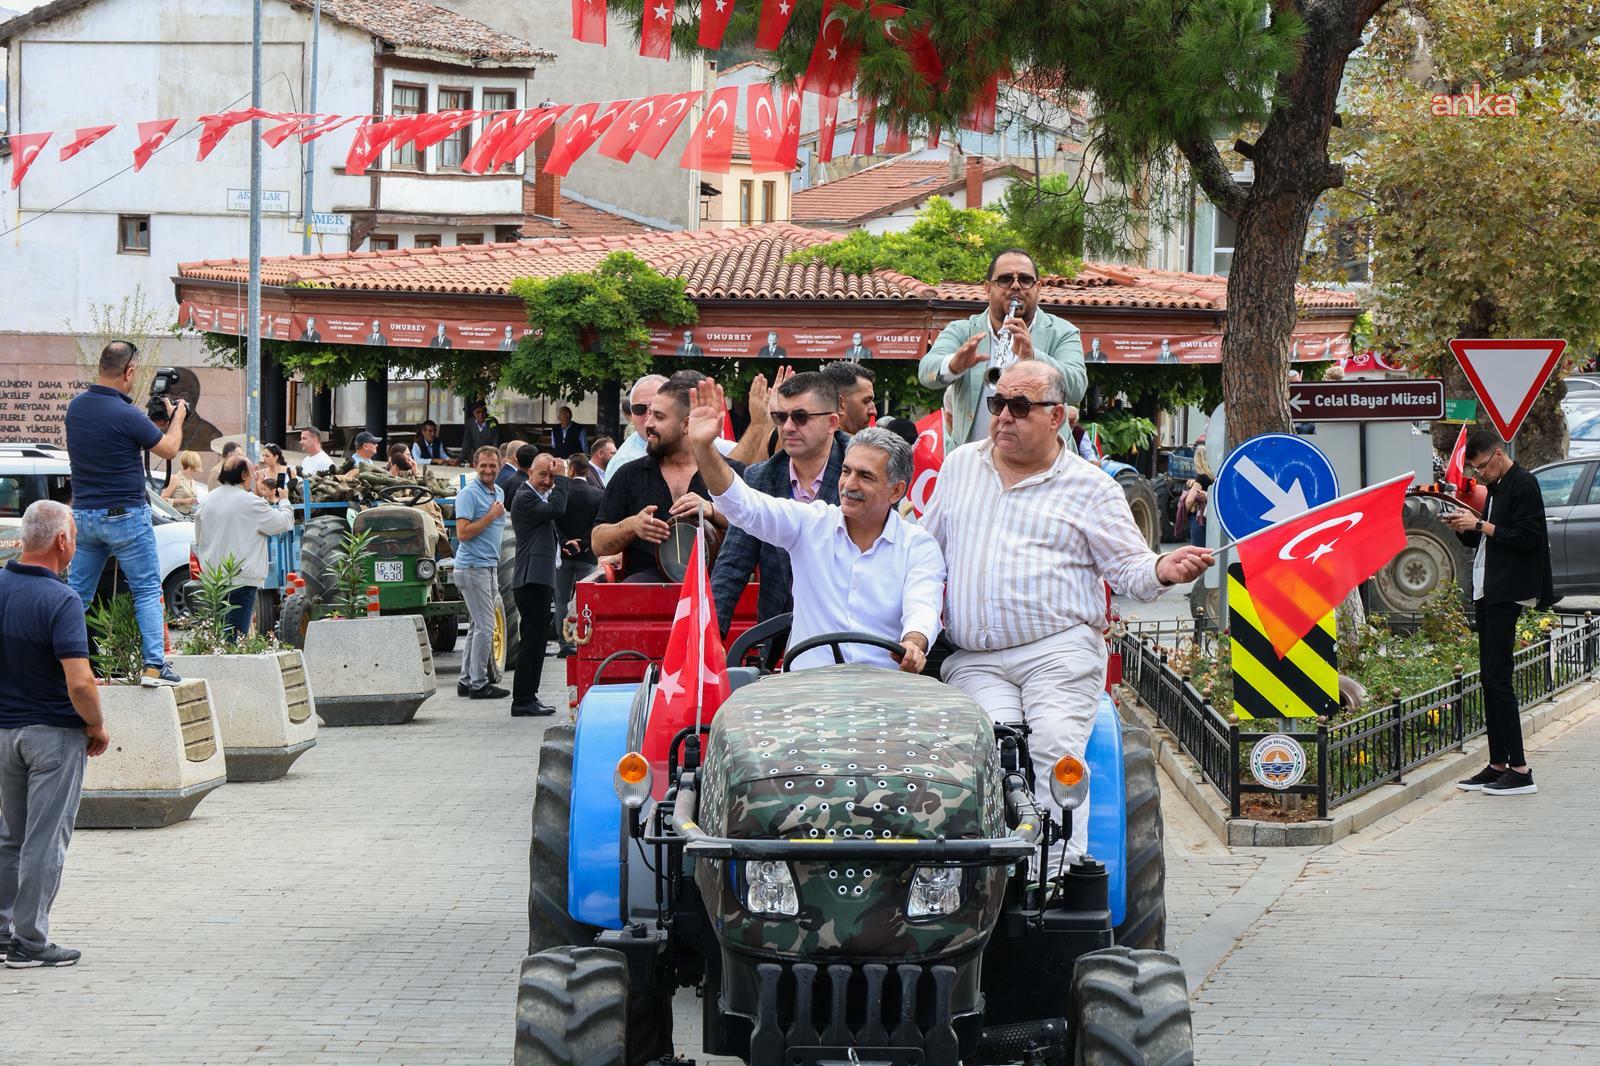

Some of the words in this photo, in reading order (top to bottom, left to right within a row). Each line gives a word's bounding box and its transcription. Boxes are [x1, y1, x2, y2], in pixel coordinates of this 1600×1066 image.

[390, 323, 426, 332] UMURBEY
[706, 333, 752, 341] UMURBEY
[1180, 341, 1218, 349] UMURBEY
[38, 381, 63, 389] DAHA
[67, 379, 90, 389] YÜKS
[1315, 393, 1348, 407] Celal
[1350, 393, 1389, 409] Bayar
[1391, 391, 1437, 406] Müzesi
[14, 403, 50, 411] MEYDAN
[26, 423, 61, 434] YÜKSELİŞ
[376, 563, 386, 572] 16
[390, 563, 402, 572] NR
[383, 572, 401, 581] 630
